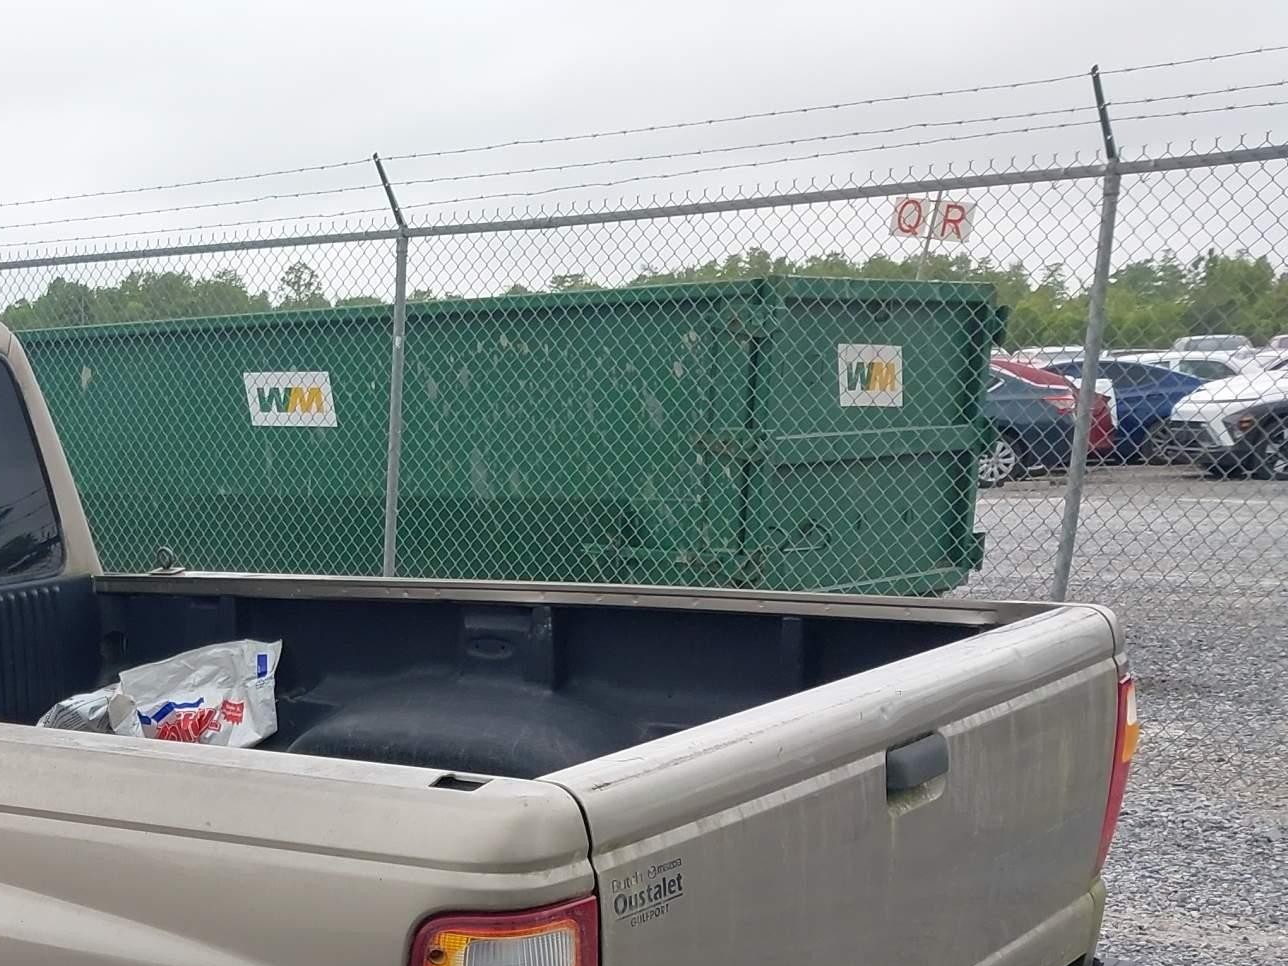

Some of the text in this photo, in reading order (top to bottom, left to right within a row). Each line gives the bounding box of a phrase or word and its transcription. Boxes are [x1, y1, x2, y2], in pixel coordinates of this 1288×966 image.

[897, 199, 966, 239] Q R
[846, 362, 898, 392] WM
[256, 386, 326, 414] WM
[614, 873, 683, 915] Oustalet
